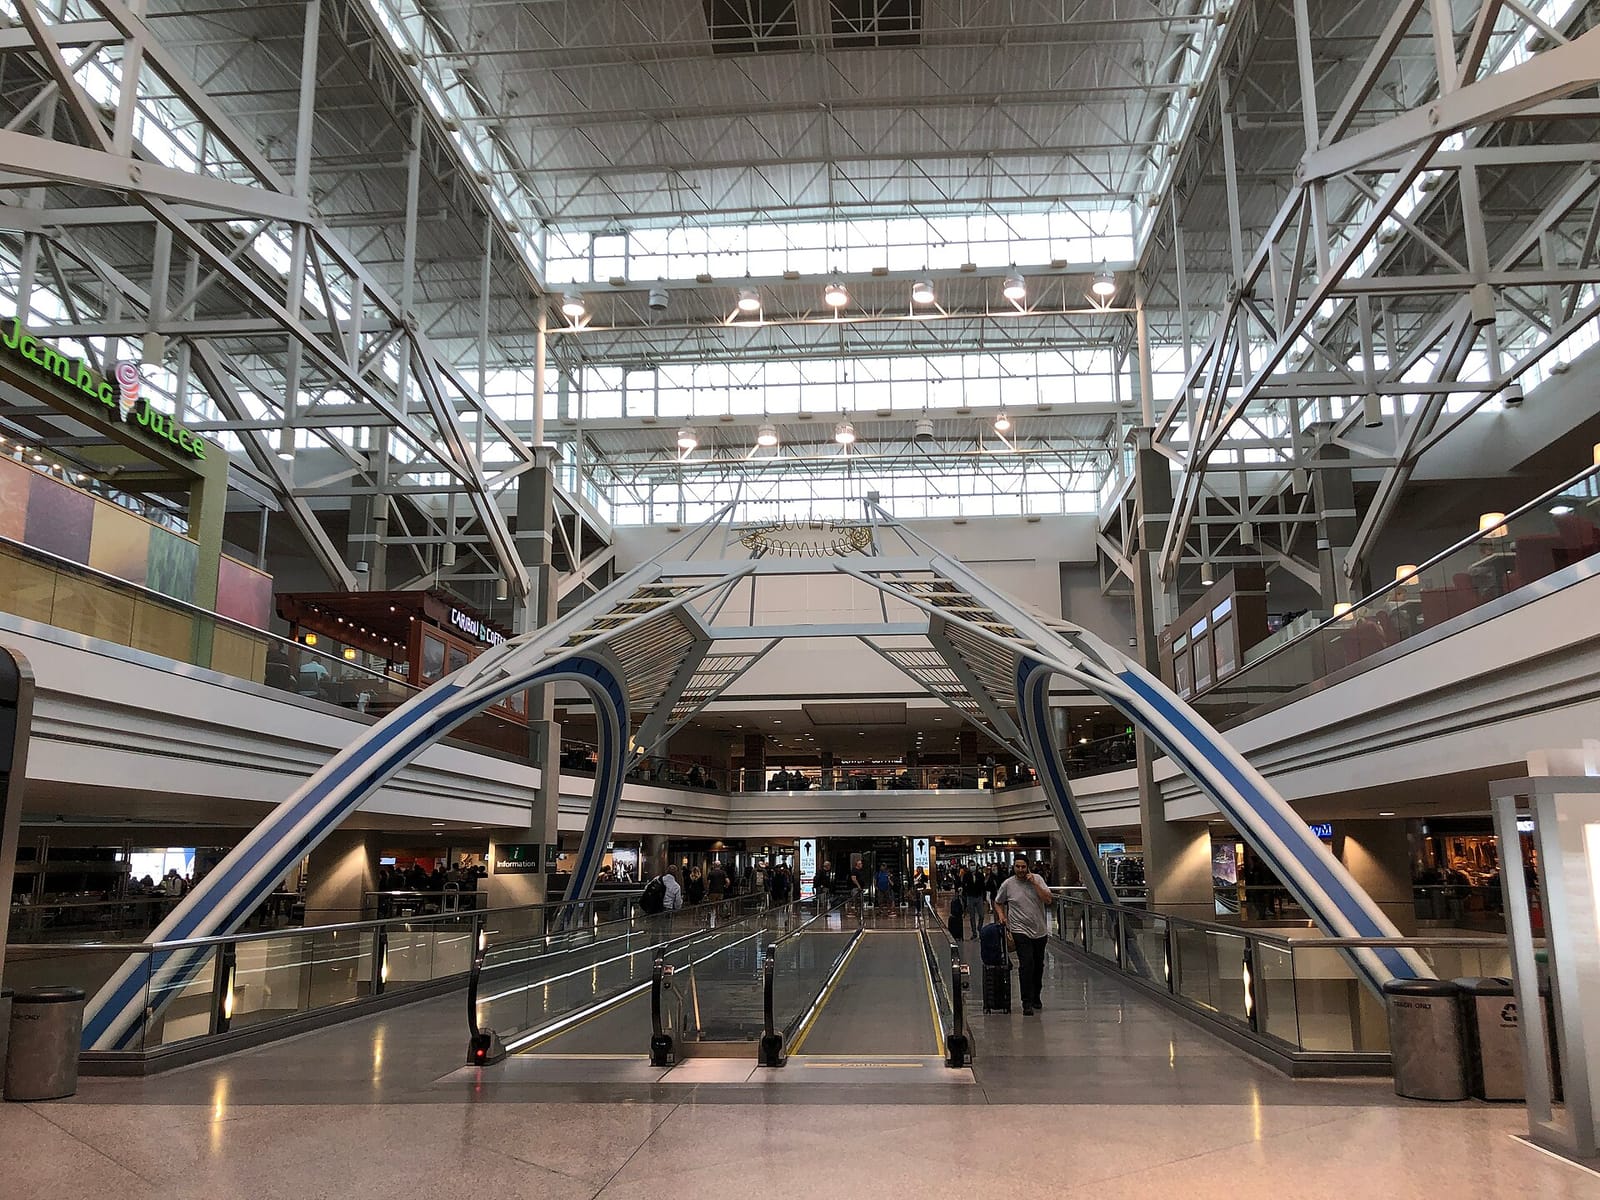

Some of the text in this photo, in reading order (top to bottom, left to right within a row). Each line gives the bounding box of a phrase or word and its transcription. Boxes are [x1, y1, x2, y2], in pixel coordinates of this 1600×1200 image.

[2, 316, 207, 461] Jamba Juice
[451, 608, 479, 636] CARIBOU
[496, 860, 536, 868] Information
